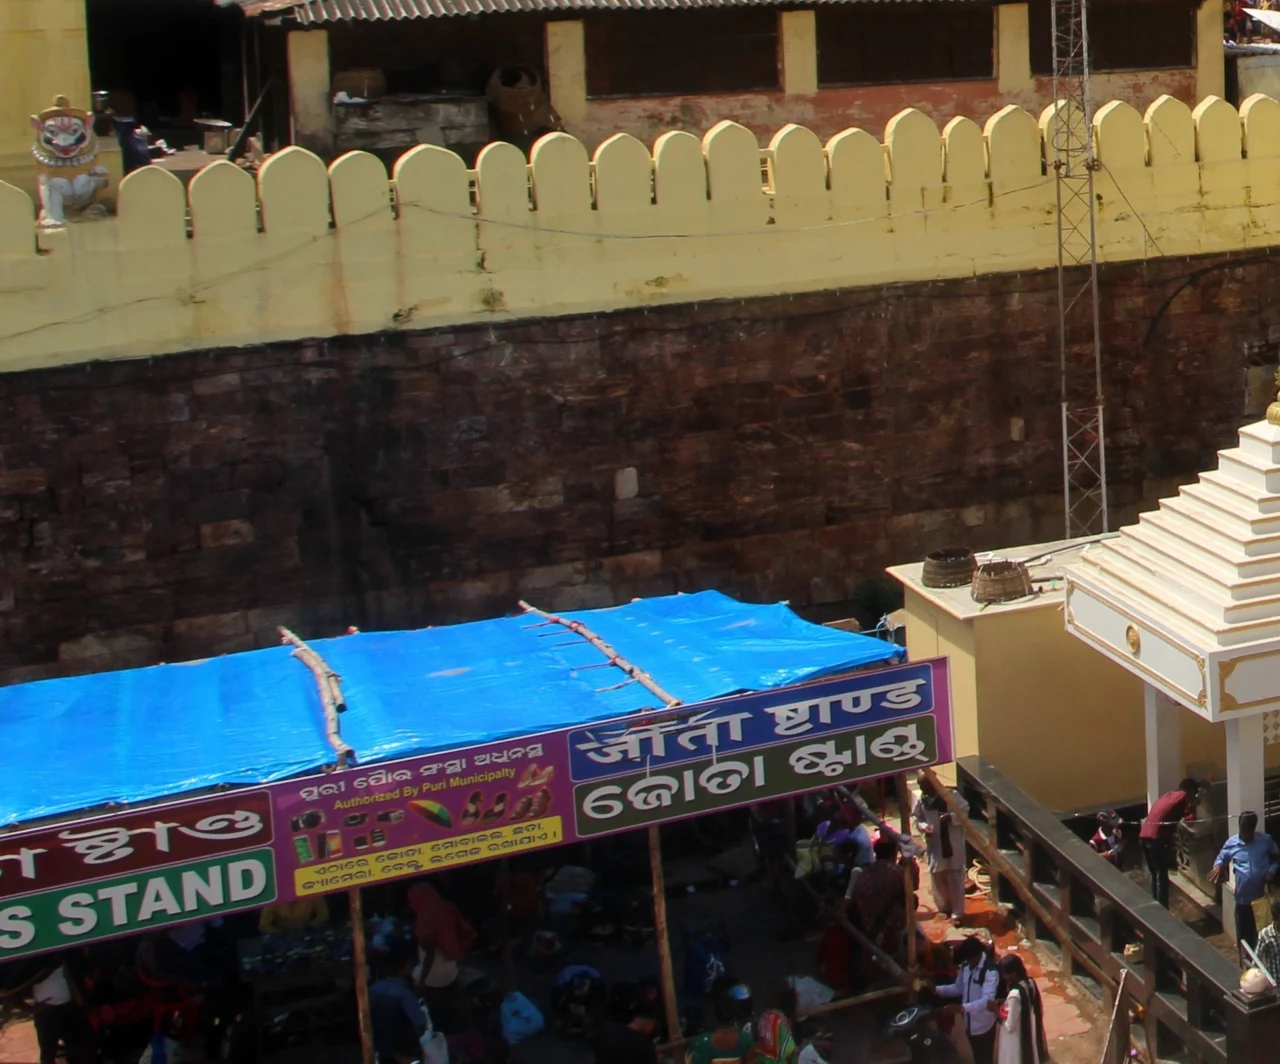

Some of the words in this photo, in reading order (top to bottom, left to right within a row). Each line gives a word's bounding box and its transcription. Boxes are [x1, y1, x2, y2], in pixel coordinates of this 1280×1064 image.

[333, 789, 400, 810] Authorized
[403, 786, 419, 797] By
[422, 780, 446, 793] Puri
[582, 756, 765, 819] ଜୋତା
[57, 858, 267, 936] STAND
